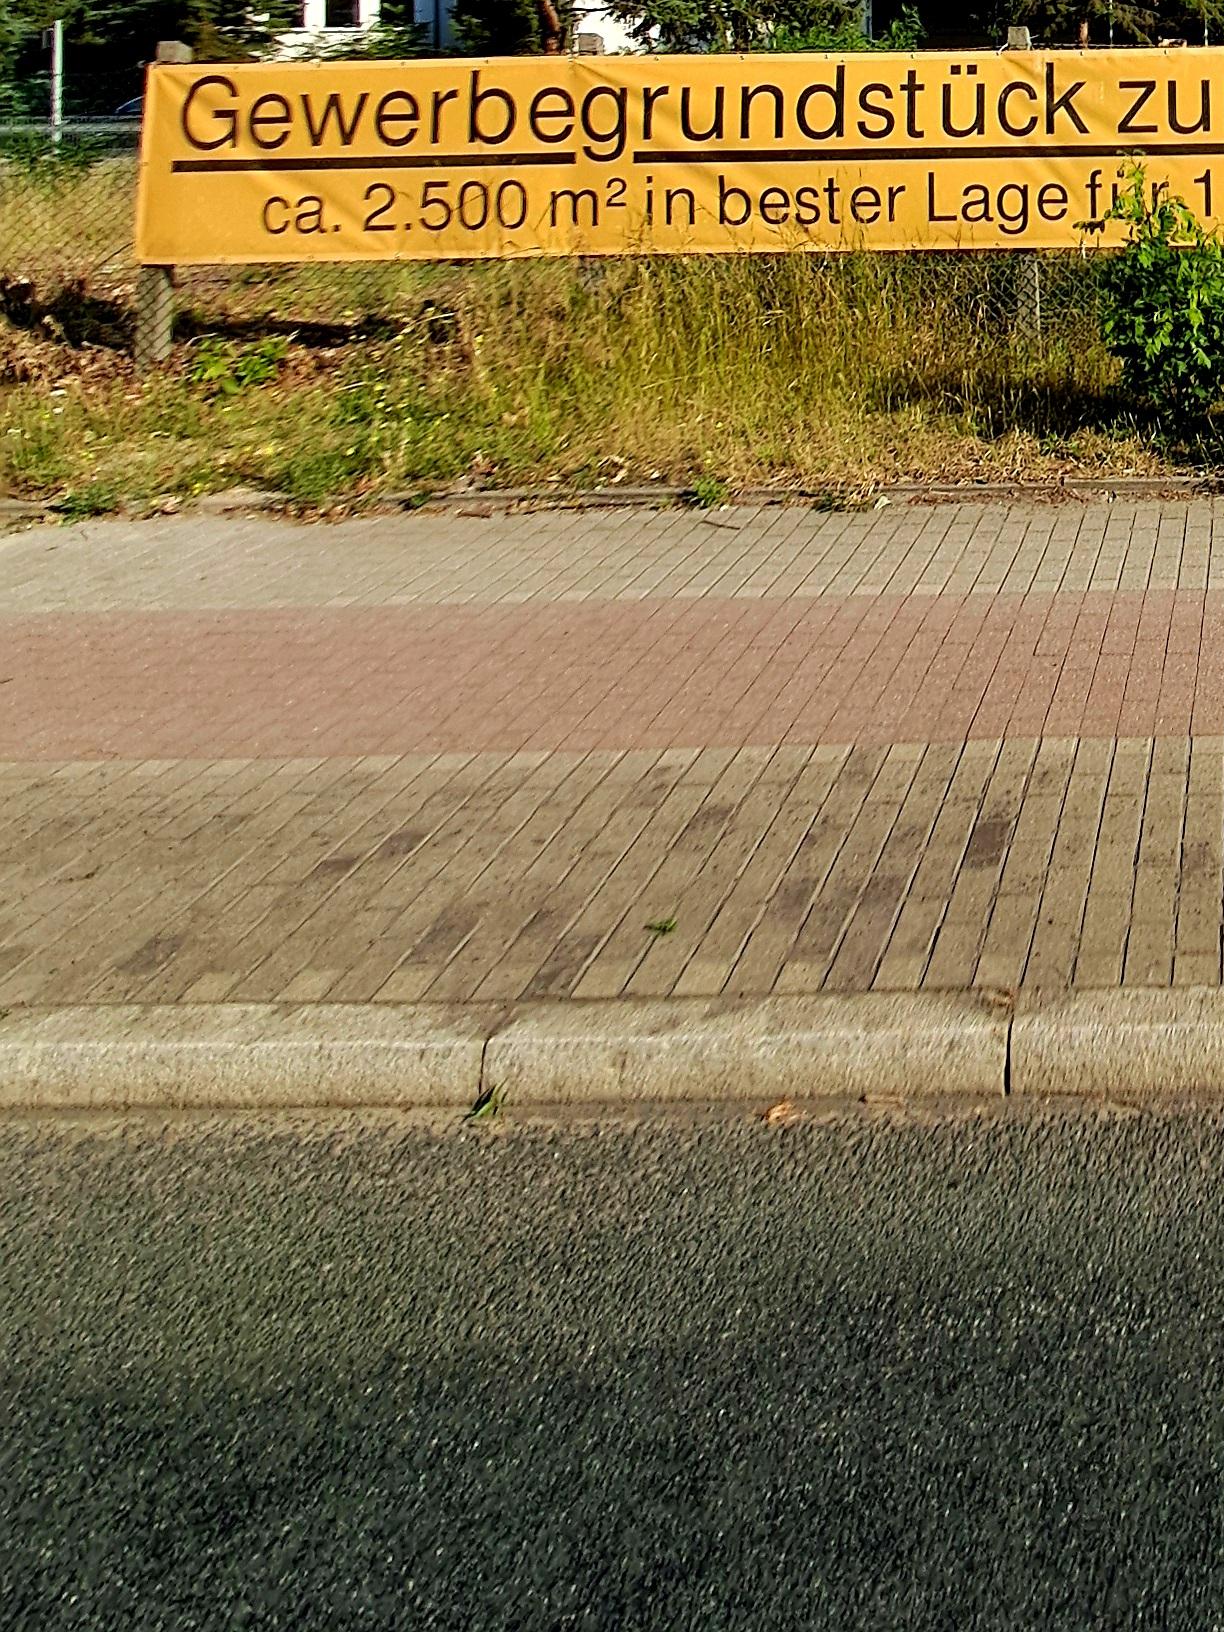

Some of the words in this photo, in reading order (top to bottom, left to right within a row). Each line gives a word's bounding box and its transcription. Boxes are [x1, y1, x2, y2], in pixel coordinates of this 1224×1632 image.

[181, 64, 1090, 163] Gewerbegrundstück
[262, 193, 343, 235] ca.
[362, 178, 528, 232] 2.500
[645, 175, 696, 226] in
[717, 173, 906, 226] bester
[927, 171, 1069, 235] Lage
